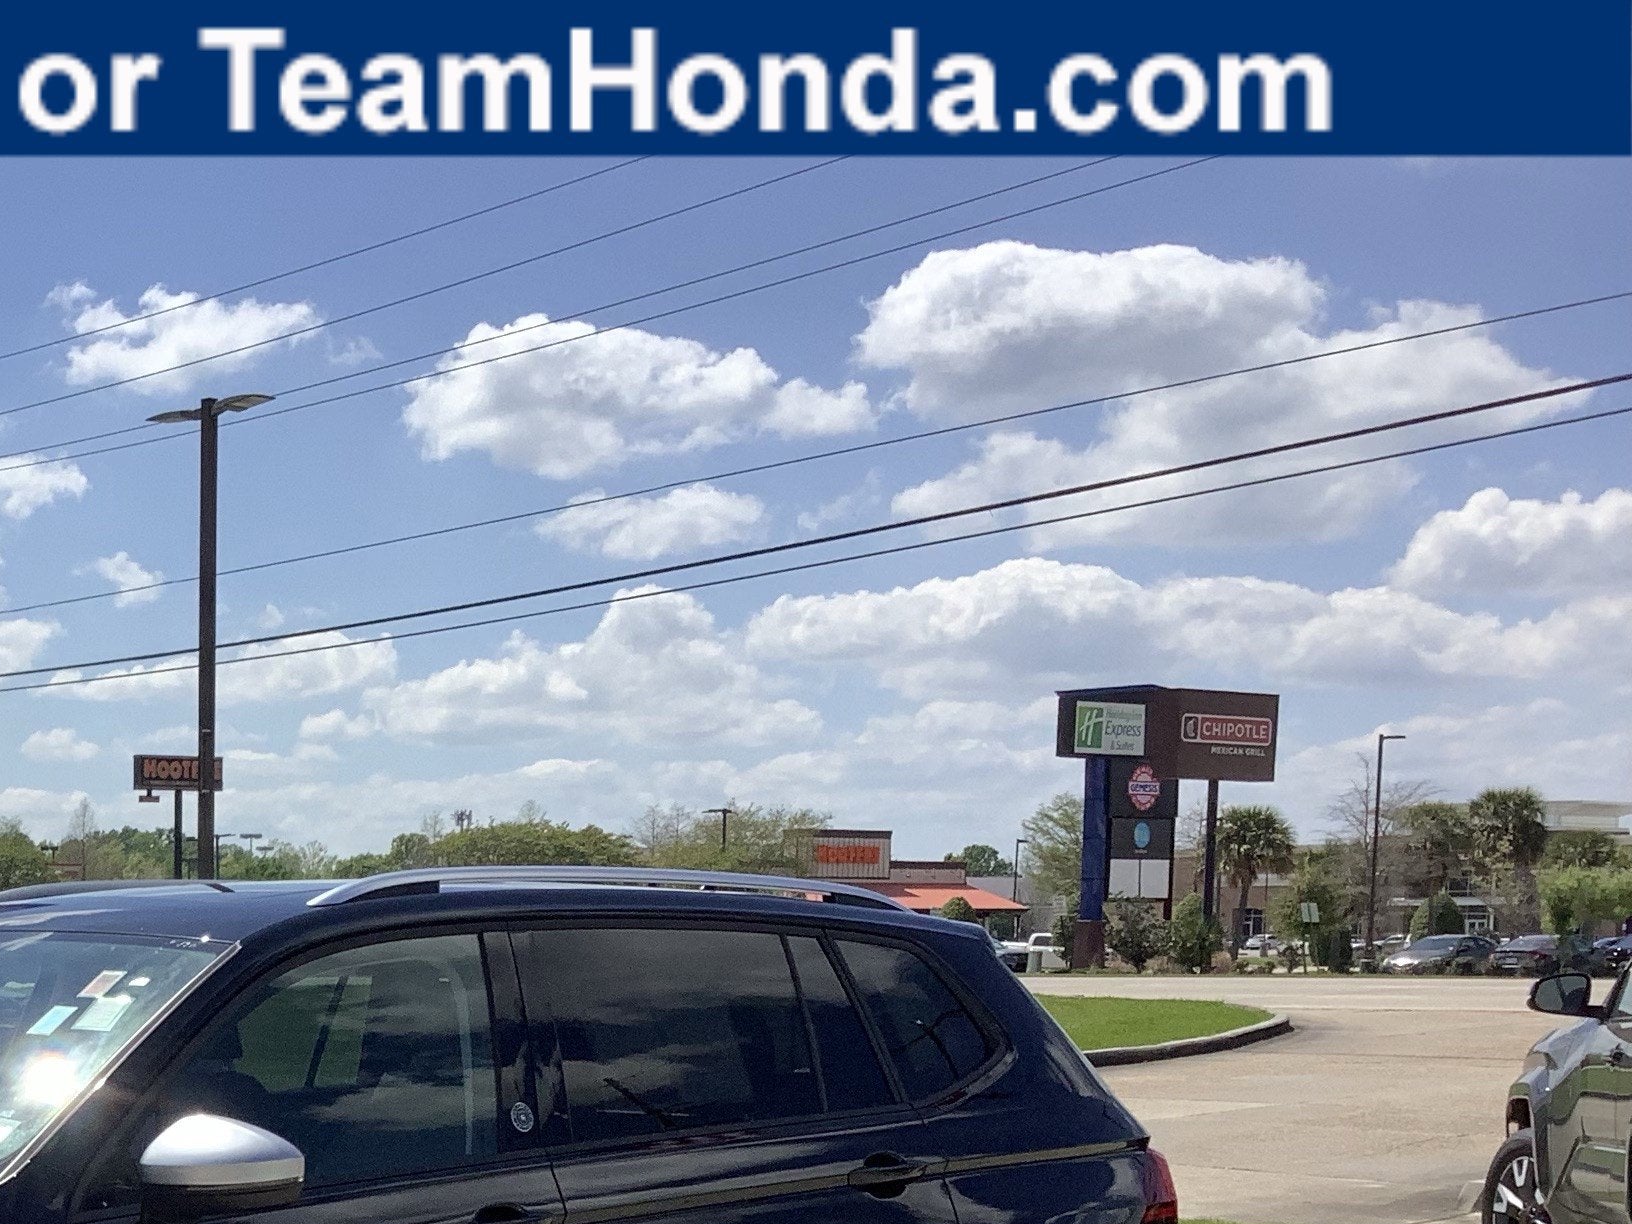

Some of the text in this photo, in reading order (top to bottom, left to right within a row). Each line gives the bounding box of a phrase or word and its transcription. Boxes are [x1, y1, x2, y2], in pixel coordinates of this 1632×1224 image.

[1105, 720, 1142, 738] Express
[1202, 722, 1268, 739] CHIPOTLE
[1210, 746, 1244, 755] MEXICAN
[143, 759, 223, 780] HOOTES
